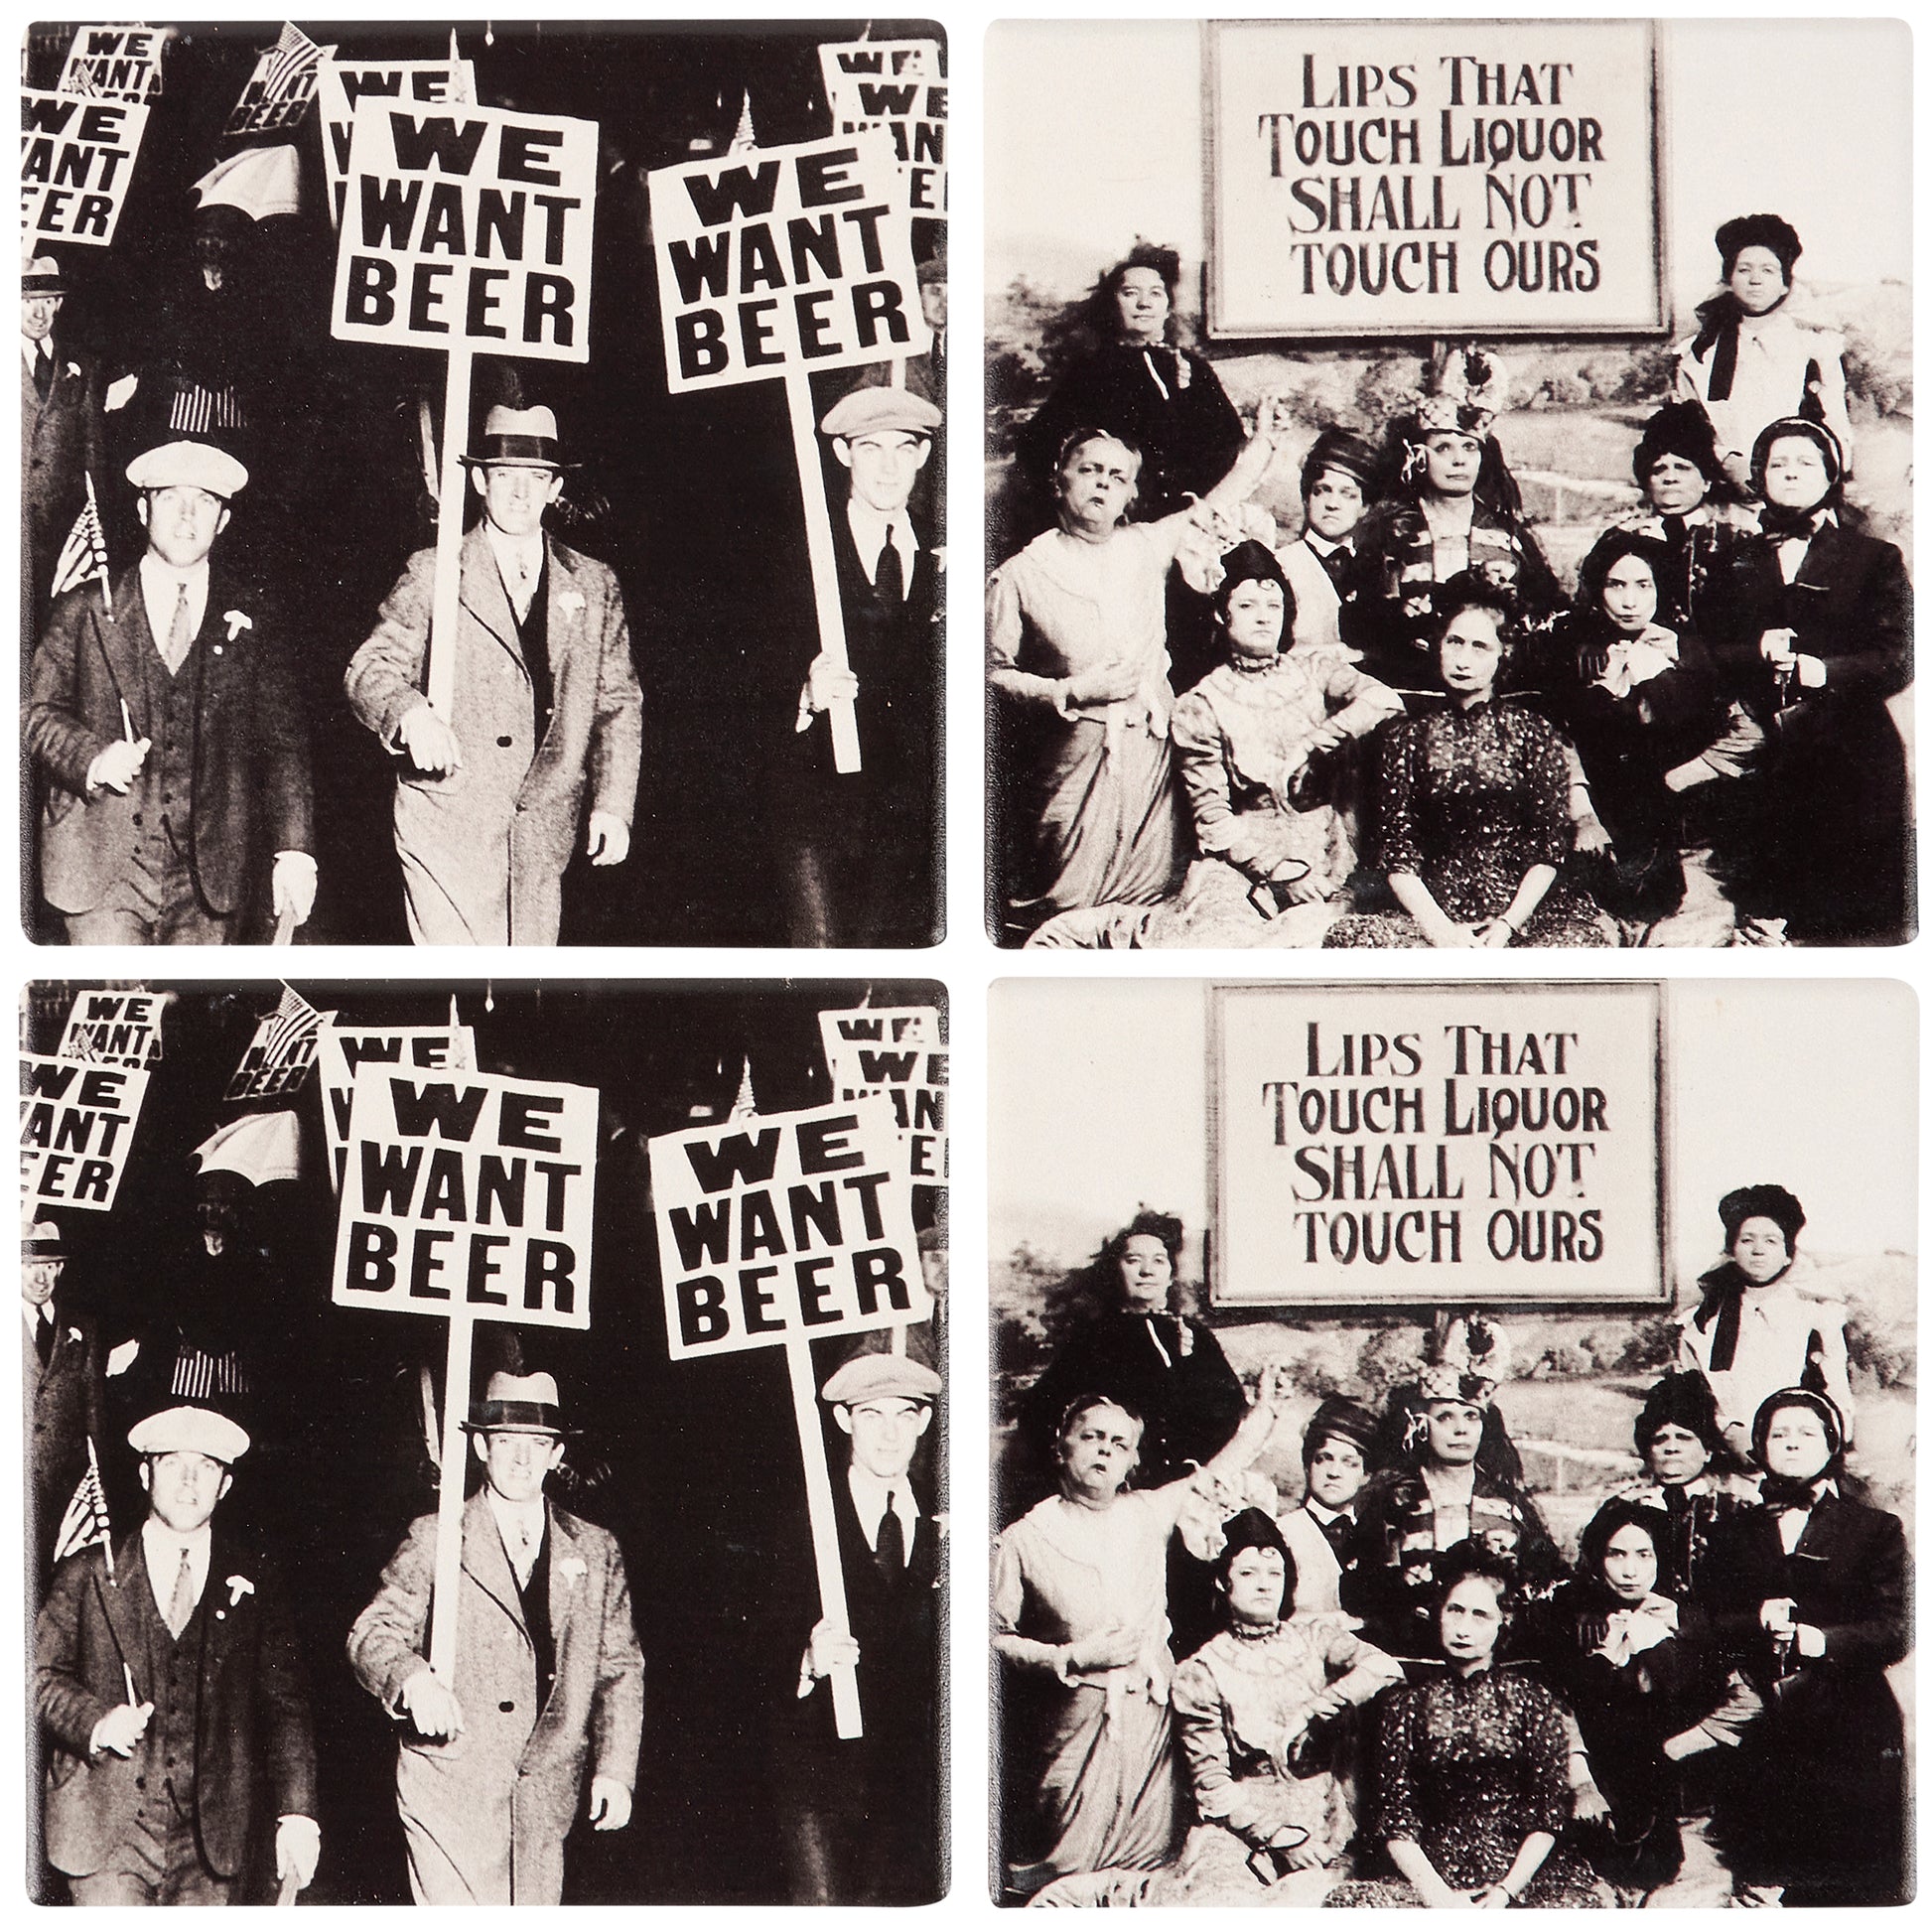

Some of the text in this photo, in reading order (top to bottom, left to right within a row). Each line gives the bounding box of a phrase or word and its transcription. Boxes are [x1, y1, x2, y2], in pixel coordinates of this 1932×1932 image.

[86, 32, 153, 57] WE
[21, 95, 126, 144] WE
[339, 70, 450, 113] WE
[858, 82, 948, 120] WE
[21, 136, 130, 193] ANT
[389, 111, 564, 187] WE
[683, 147, 866, 227] WE
[1288, 173, 1591, 234] SHALL NOT
[360, 174, 581, 265] WANT
[668, 204, 890, 305] WANT
[1290, 239, 1600, 296] TOUCH OURS
[345, 255, 575, 346] BEER
[675, 280, 910, 379] BEER
[86, 997, 153, 1022] WE
[20, 1058, 127, 1109] WE
[339, 1036, 450, 1079] WE
[858, 1050, 949, 1086] WE
[20, 1100, 130, 1158] ANT
[389, 1077, 564, 1154] WE
[683, 1114, 866, 1194] WE
[1292, 1143, 1595, 1204] SHALL NOT
[360, 1140, 582, 1232] WANT
[668, 1172, 891, 1271] WANT
[1294, 1209, 1603, 1264] TOUCH OURS
[346, 1221, 576, 1313] BEER
[676, 1247, 911, 1346] BEER
